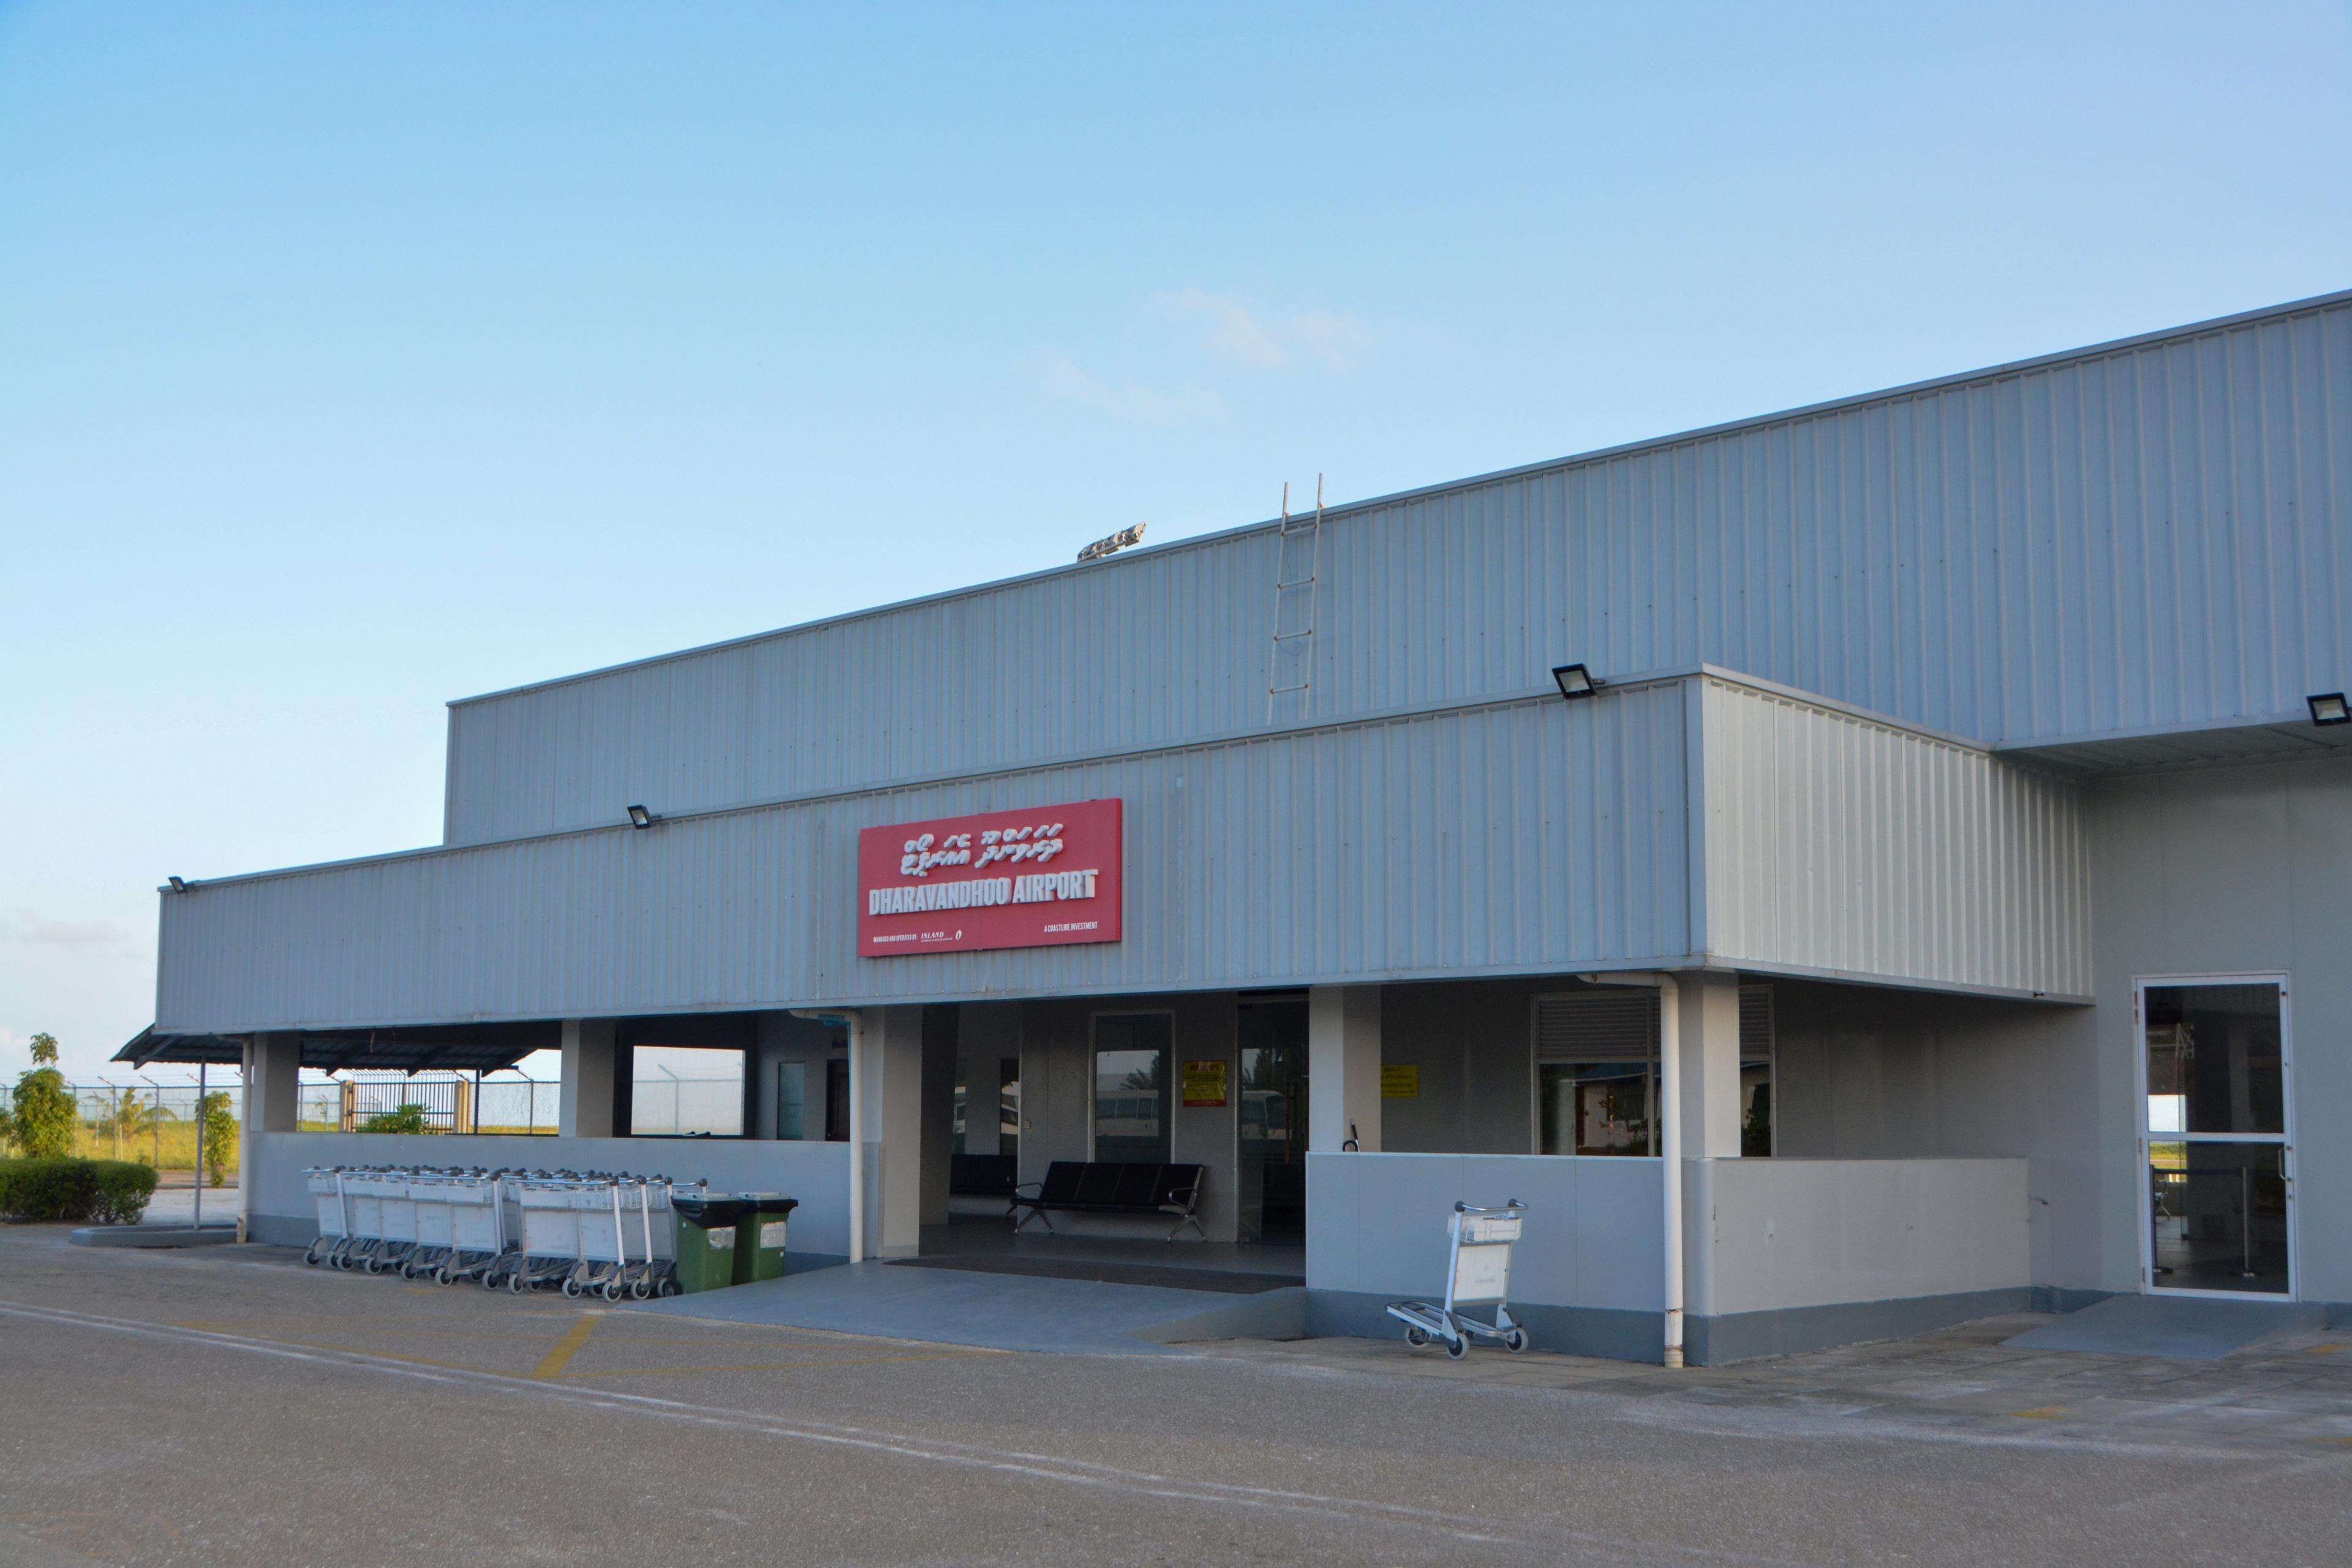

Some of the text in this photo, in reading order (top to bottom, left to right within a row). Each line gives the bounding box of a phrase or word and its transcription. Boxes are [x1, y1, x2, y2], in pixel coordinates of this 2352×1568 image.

[870, 869, 1098, 915] DHARAVANDHOO AIRPORT
[1048, 924, 1070, 932] COASTLINE
[1071, 922, 1098, 931] INVESTMENT
